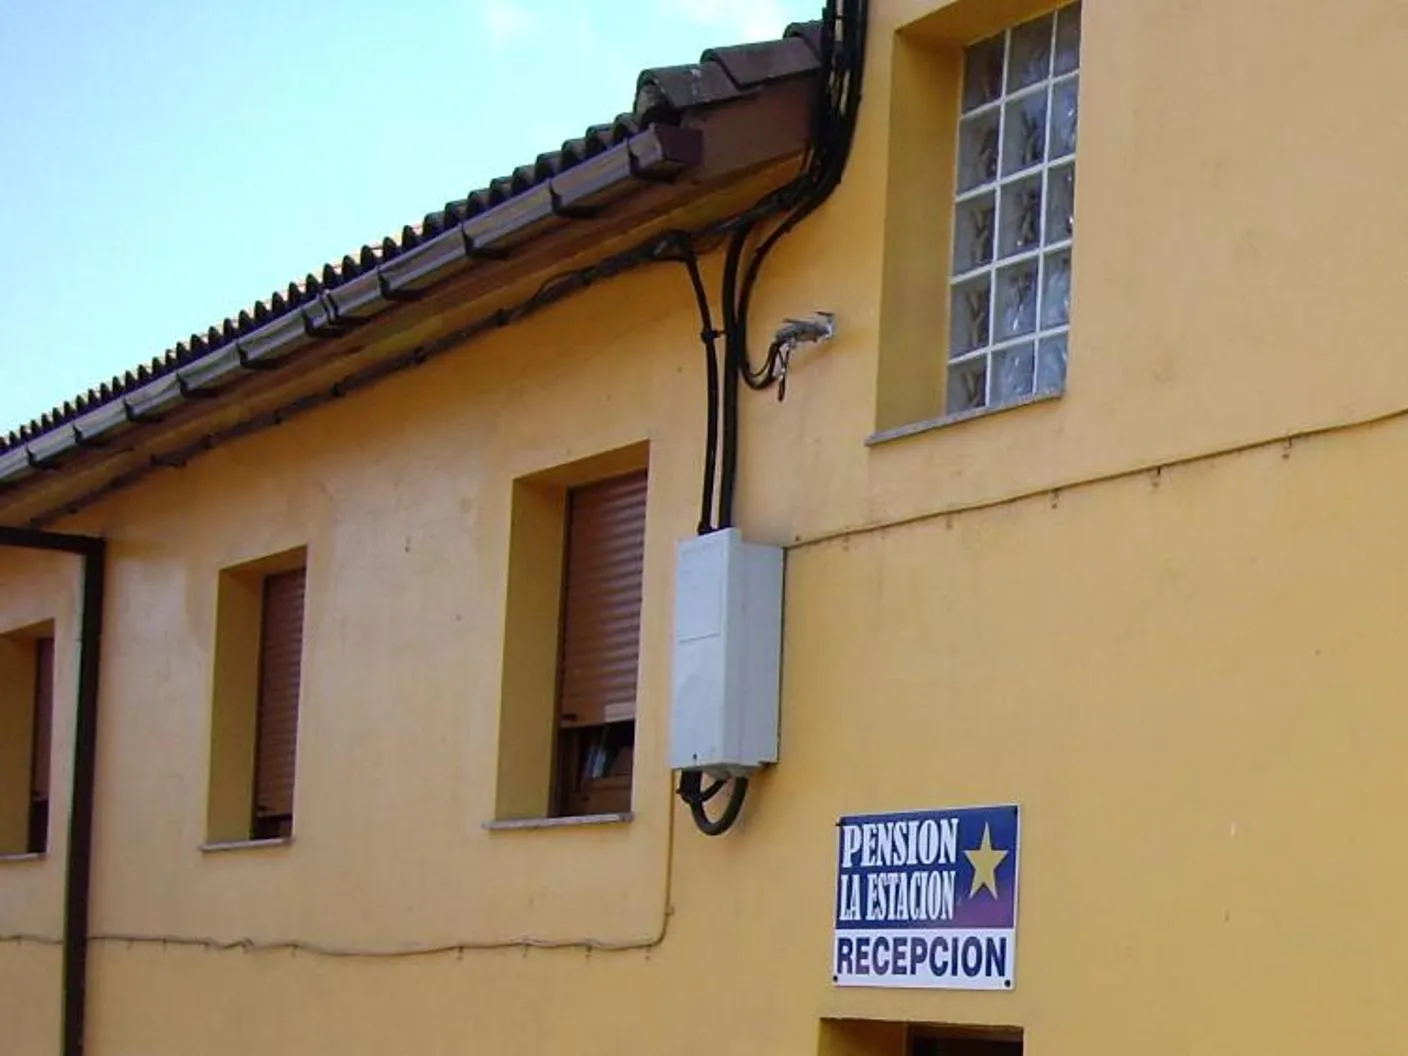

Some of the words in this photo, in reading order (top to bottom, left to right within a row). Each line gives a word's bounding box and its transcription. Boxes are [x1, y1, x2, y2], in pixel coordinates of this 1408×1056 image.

[842, 818, 959, 868] PENSION
[839, 874, 861, 921] LA
[866, 871, 956, 920] ESTACION
[837, 936, 1007, 977] RECEPCION
